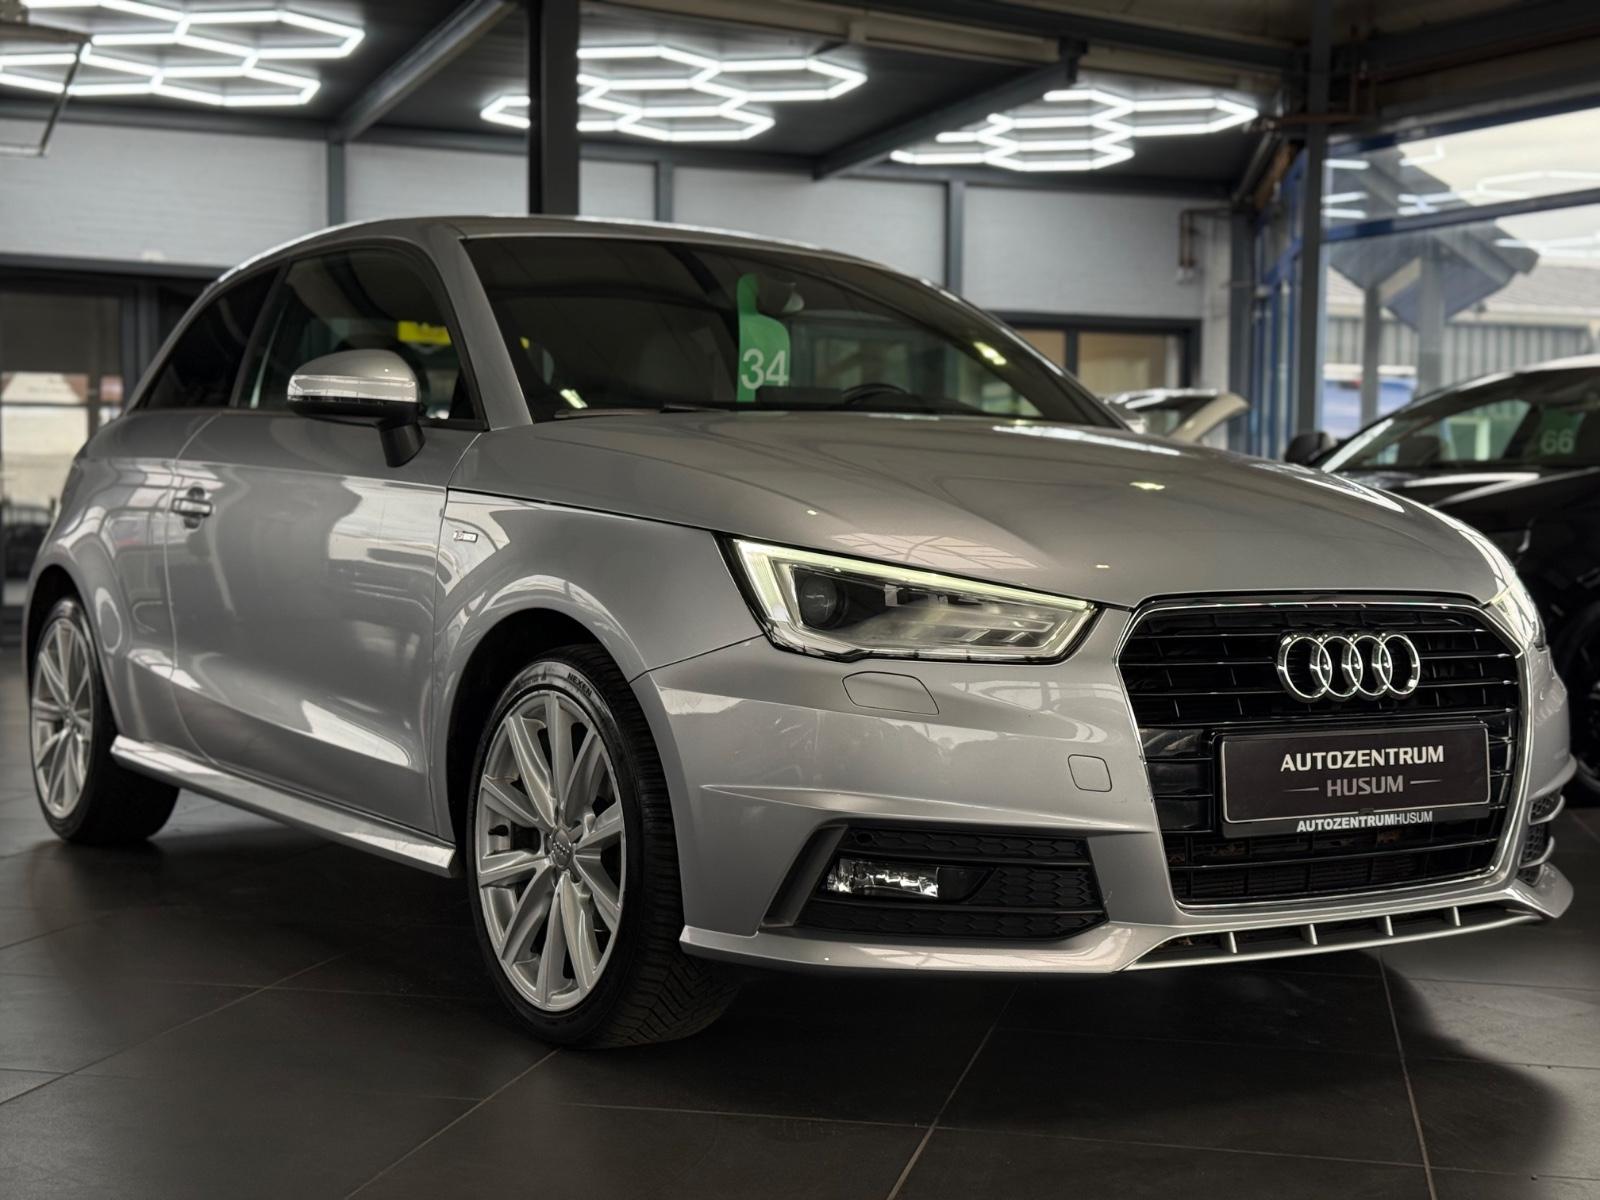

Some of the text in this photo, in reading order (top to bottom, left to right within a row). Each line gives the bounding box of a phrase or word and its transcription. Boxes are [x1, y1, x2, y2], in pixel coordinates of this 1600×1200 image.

[741, 348, 789, 390] 34
[1540, 428, 1574, 455] 66
[567, 672, 593, 697] NEXEN
[1280, 745, 1444, 772] AUTOZENTRUM
[1326, 775, 1404, 797] HUSUM
